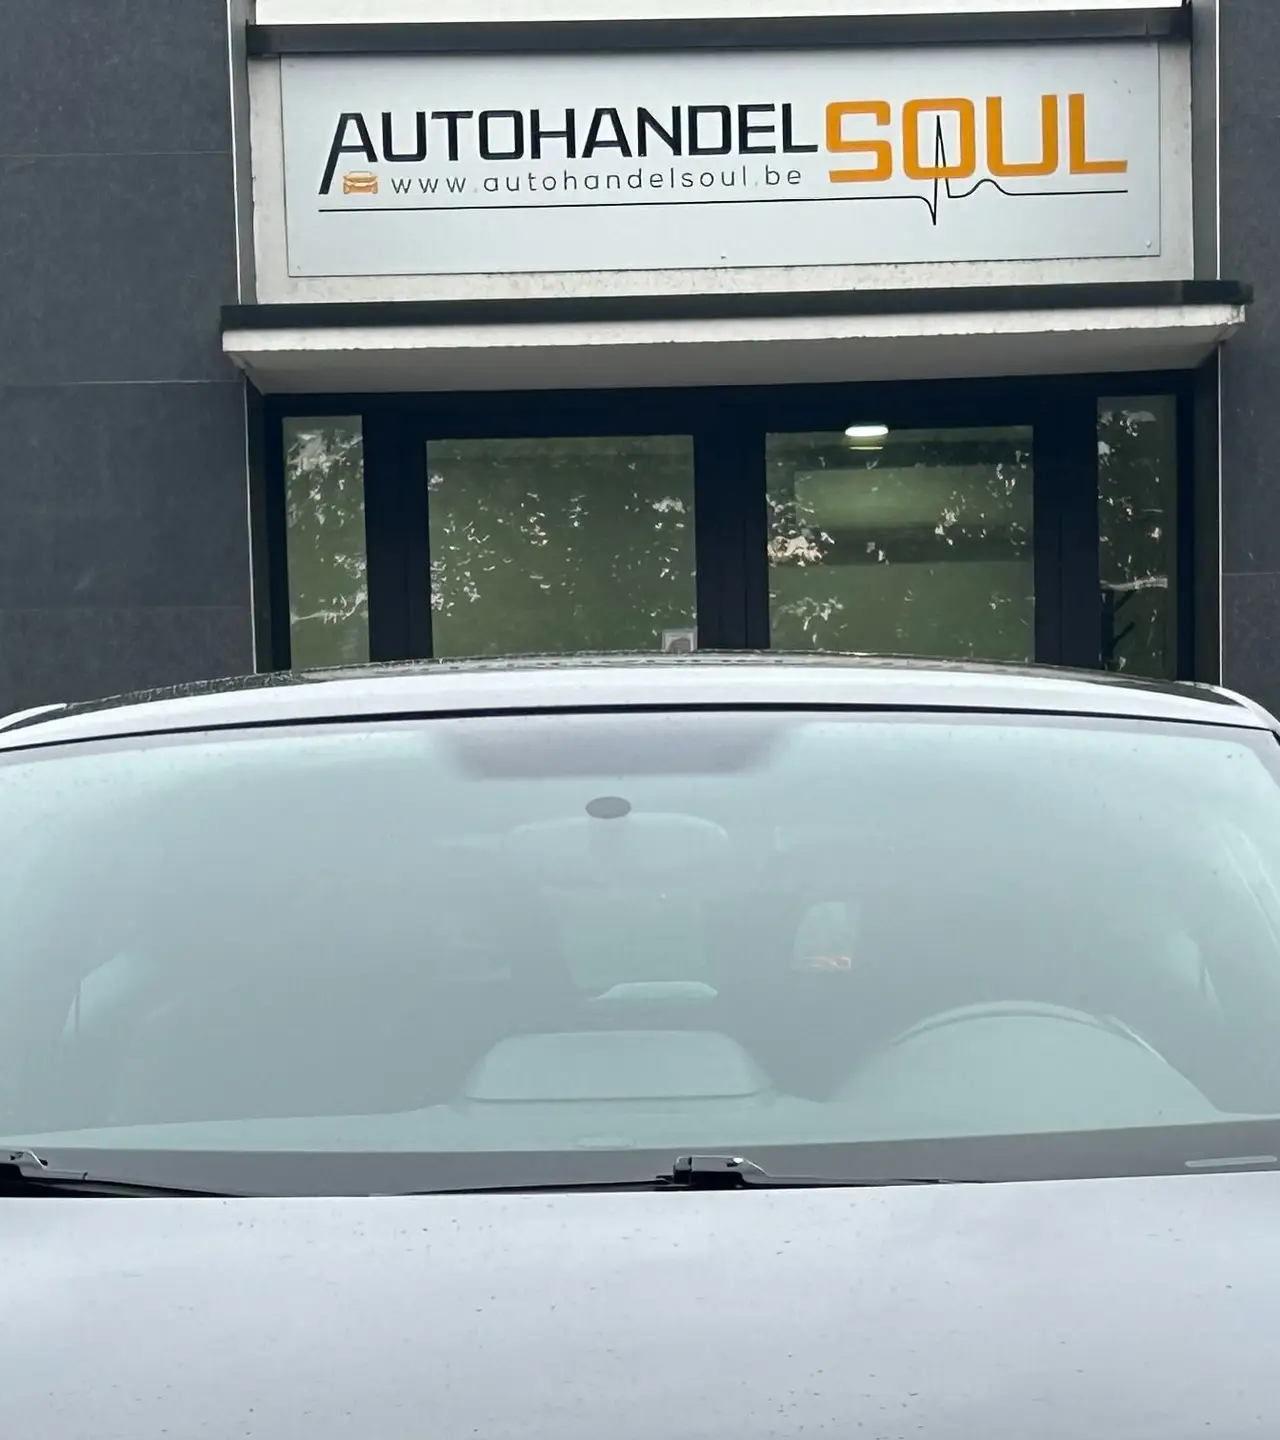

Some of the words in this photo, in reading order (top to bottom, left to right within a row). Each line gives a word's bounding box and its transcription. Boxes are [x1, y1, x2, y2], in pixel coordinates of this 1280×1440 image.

[318, 103, 819, 196] AUTOHANDEL
[824, 93, 1128, 183] SOUL
[391, 165, 803, 196] www.autohandelsoul.be
